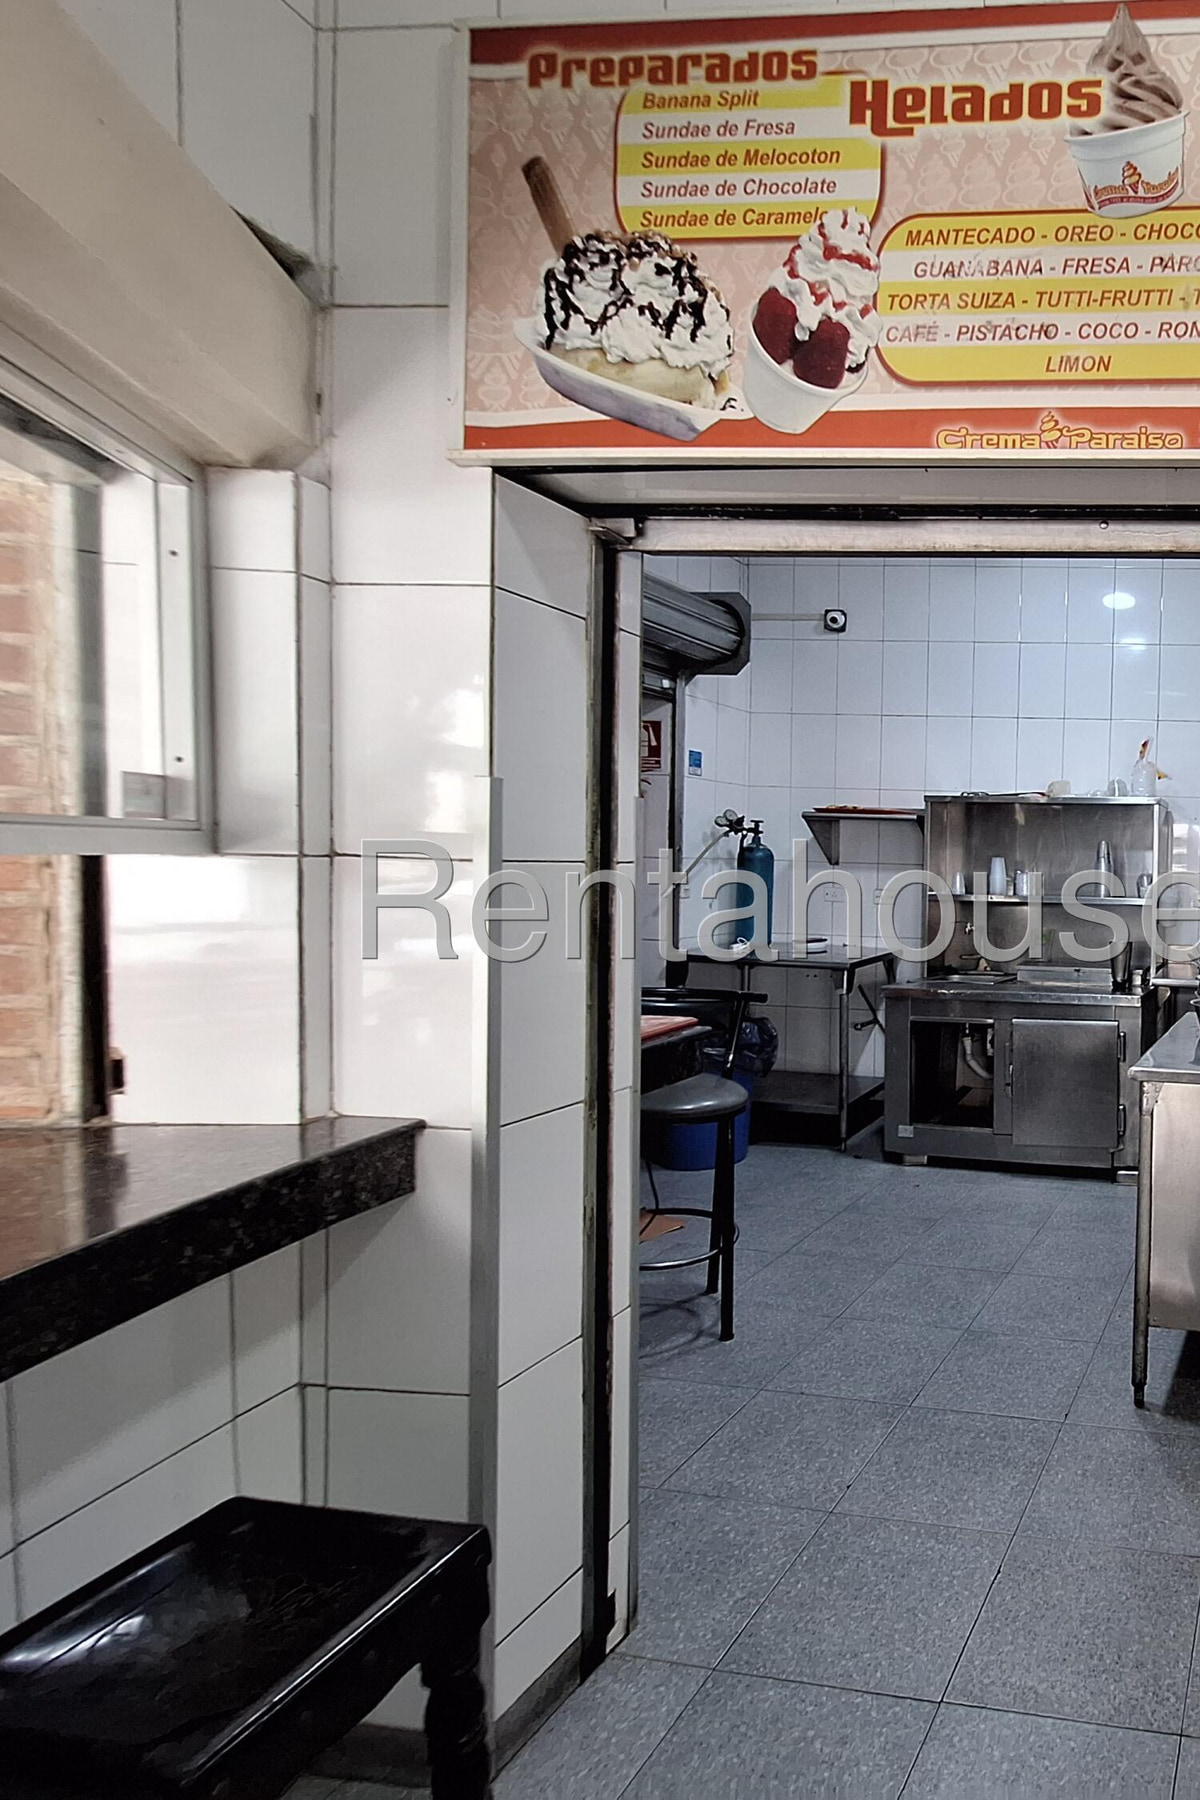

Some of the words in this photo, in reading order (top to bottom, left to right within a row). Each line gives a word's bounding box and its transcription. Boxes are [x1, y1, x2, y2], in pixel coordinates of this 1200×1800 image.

[528, 49, 818, 88] Preparados
[642, 91, 711, 109] Banana
[717, 89, 760, 110] Split
[849, 79, 1102, 137] Helados
[642, 121, 711, 139] Sundae
[717, 120, 738, 137] de
[744, 118, 796, 136] Fresa
[641, 151, 710, 168] Sundae
[716, 150, 738, 167] de
[743, 148, 840, 165] Melocoton
[641, 181, 709, 198] Sundae
[715, 180, 737, 196] de
[743, 177, 837, 195] Chocolate
[640, 210, 709, 228] Sundae
[714, 209, 736, 226] de
[905, 227, 1036, 247] MANTECADO
[1054, 224, 1114, 243] OREO
[914, 258, 1044, 278] GUANABANA
[1062, 256, 1130, 276] FRESA
[888, 293, 951, 311] TORTA
[957, 292, 1016, 310] SUIZA
[1036, 288, 1174, 308] TUTTI-FRUTTI
[886, 321, 939, 342] CAFÉ
[956, 322, 1059, 342] PISTACHO
[1078, 321, 1139, 340] COCO
[1045, 355, 1112, 373] LIMON
[936, 427, 1040, 449] Crema
[1062, 425, 1183, 449] Paraiso
